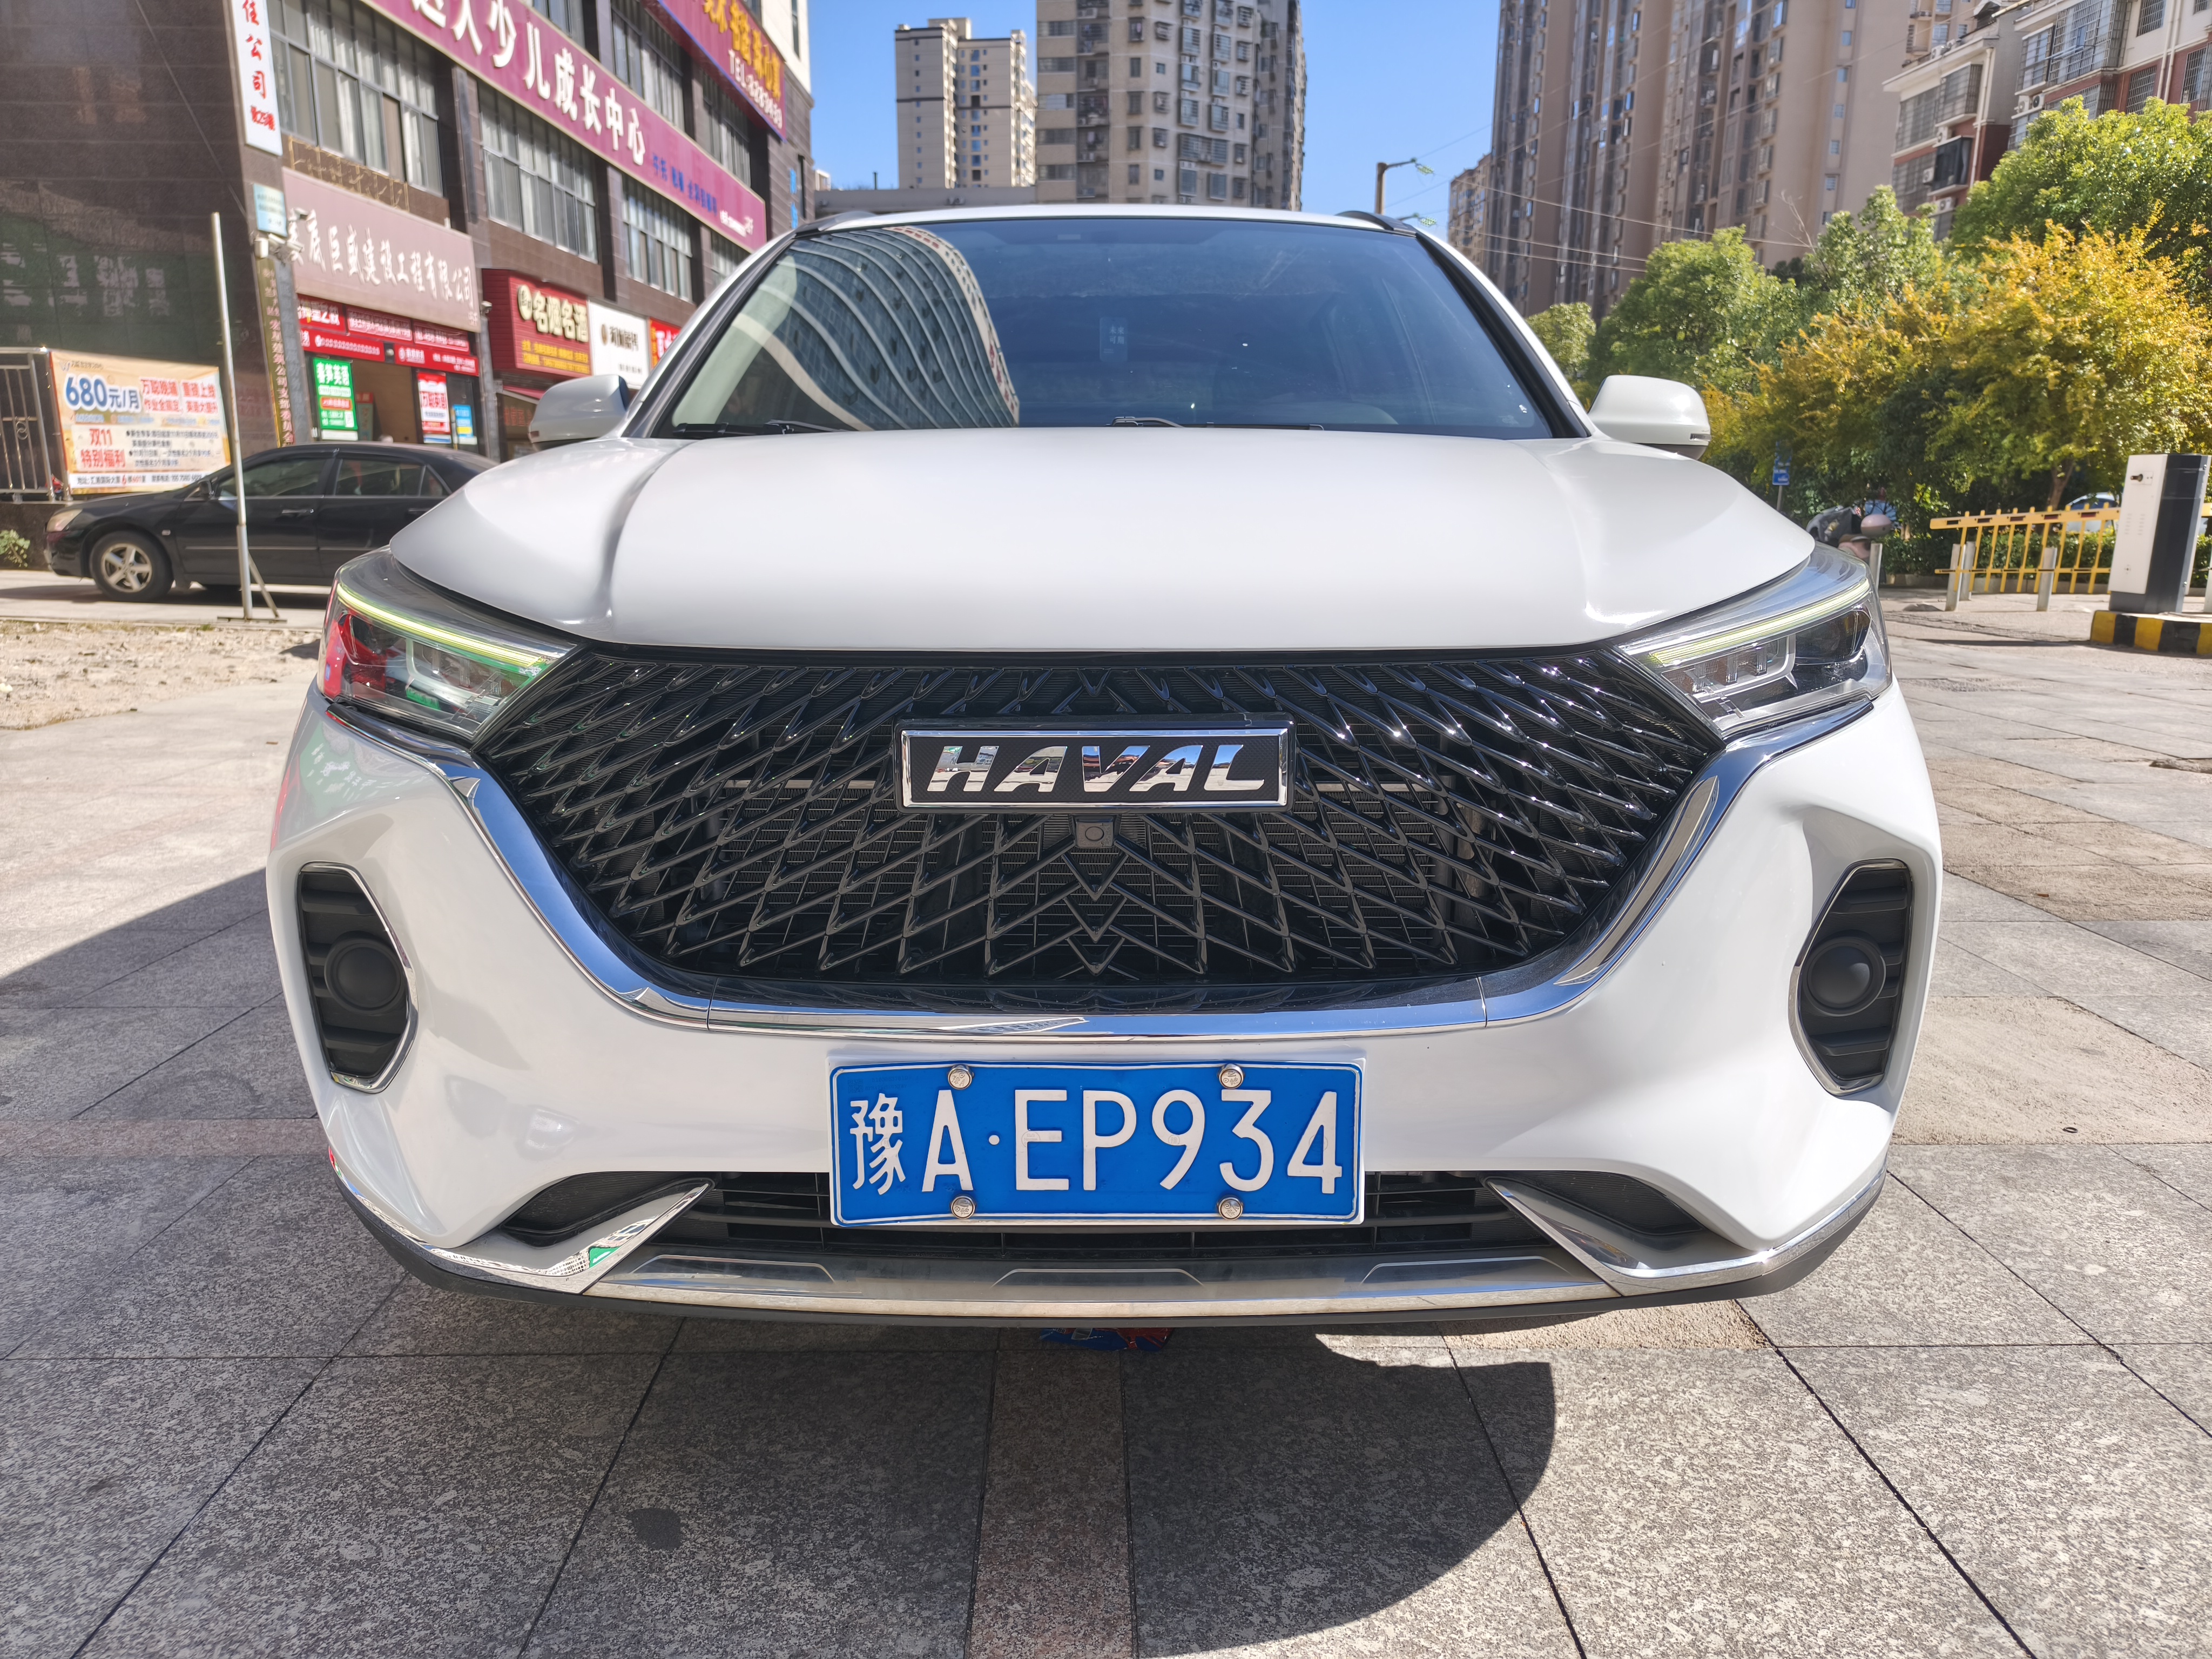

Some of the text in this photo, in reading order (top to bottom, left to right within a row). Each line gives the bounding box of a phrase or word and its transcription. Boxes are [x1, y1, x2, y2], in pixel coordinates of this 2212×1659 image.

[532, 291, 589, 342] 名烟名酒
[81, 449, 126, 468] 特别福利
[89, 428, 112, 446] 双11
[927, 745, 1265, 792] HAVAL
[849, 1089, 1343, 1195] 豫A·EP934
